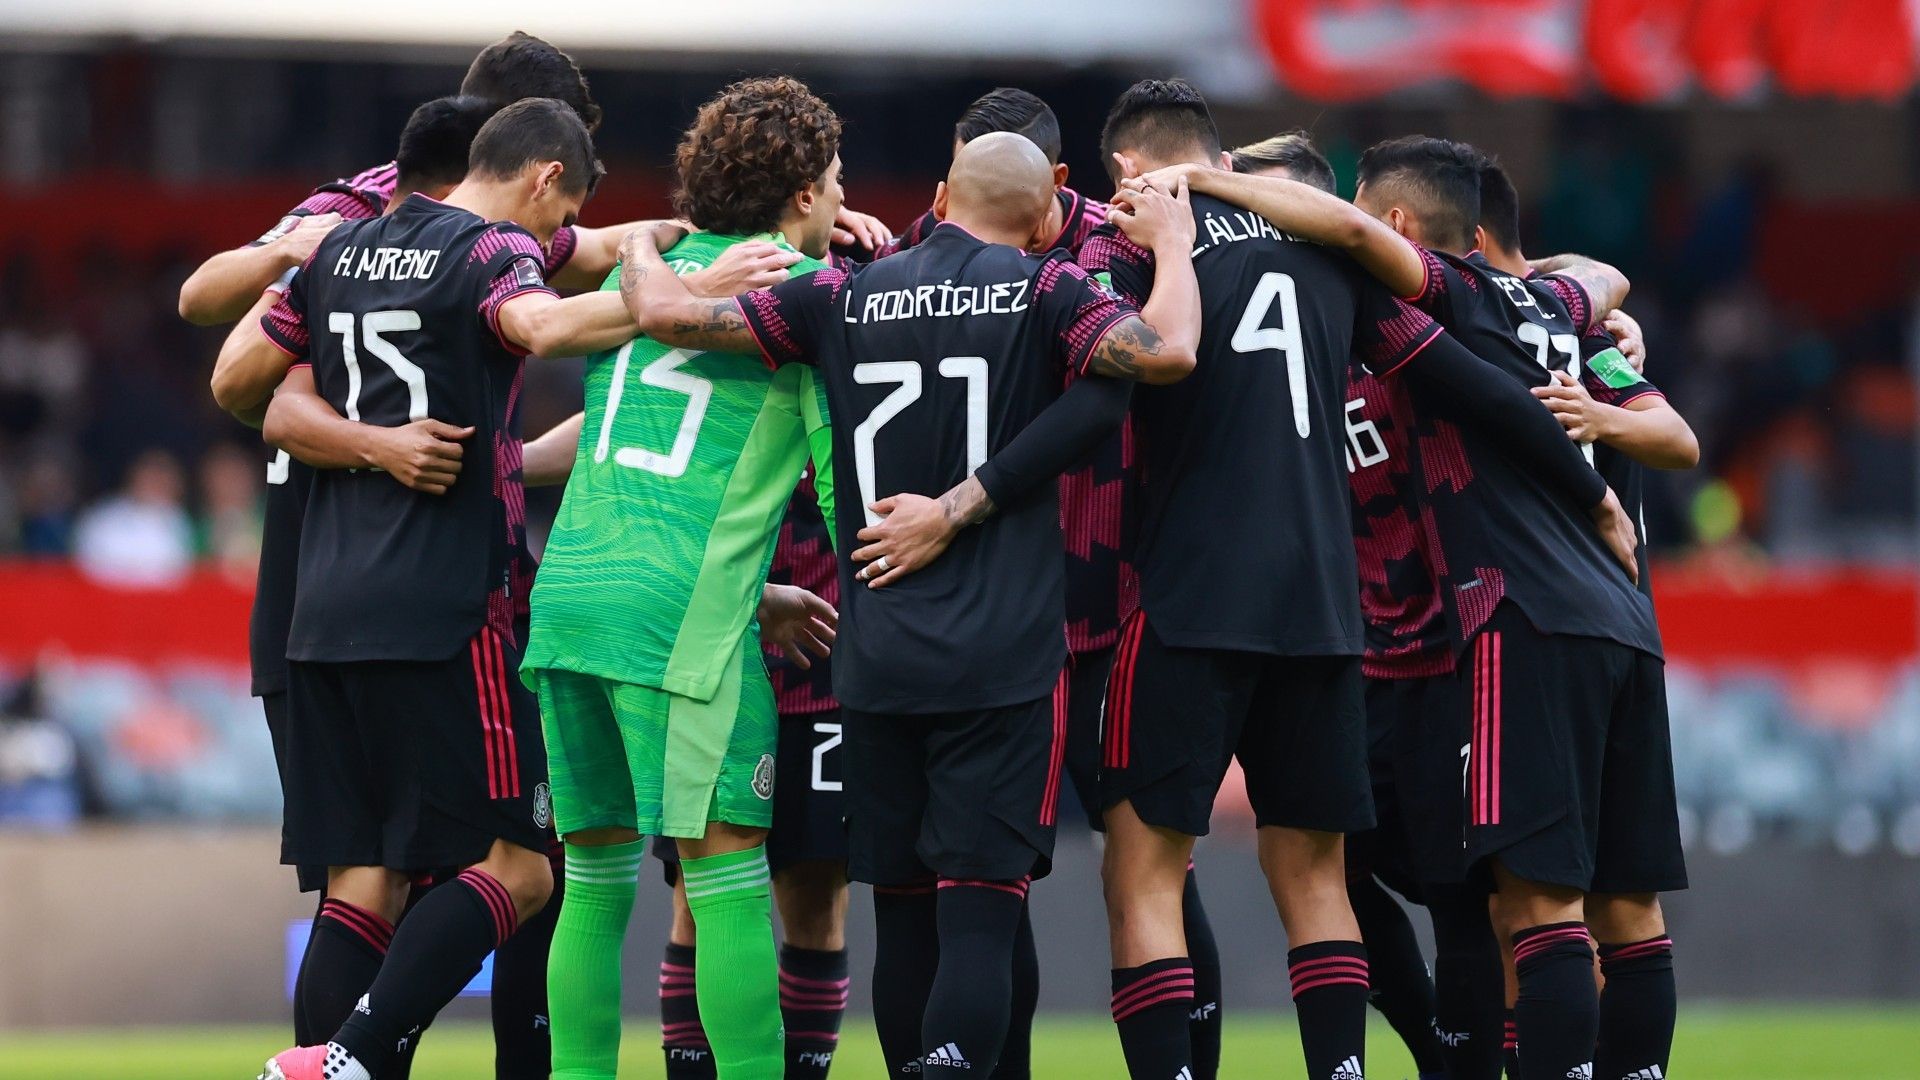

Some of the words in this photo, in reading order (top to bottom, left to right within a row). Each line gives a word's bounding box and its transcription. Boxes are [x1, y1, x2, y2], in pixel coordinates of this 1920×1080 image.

[1204, 211, 1324, 246] ÁLVA
[333, 245, 357, 277] H.
[354, 247, 441, 281] MORENO
[863, 279, 1029, 324] RODRÍGUEZ
[1231, 272, 1310, 438] 4
[594, 340, 712, 478] 13
[853, 356, 988, 527] 21
[926, 1056, 971, 1069] adidas
